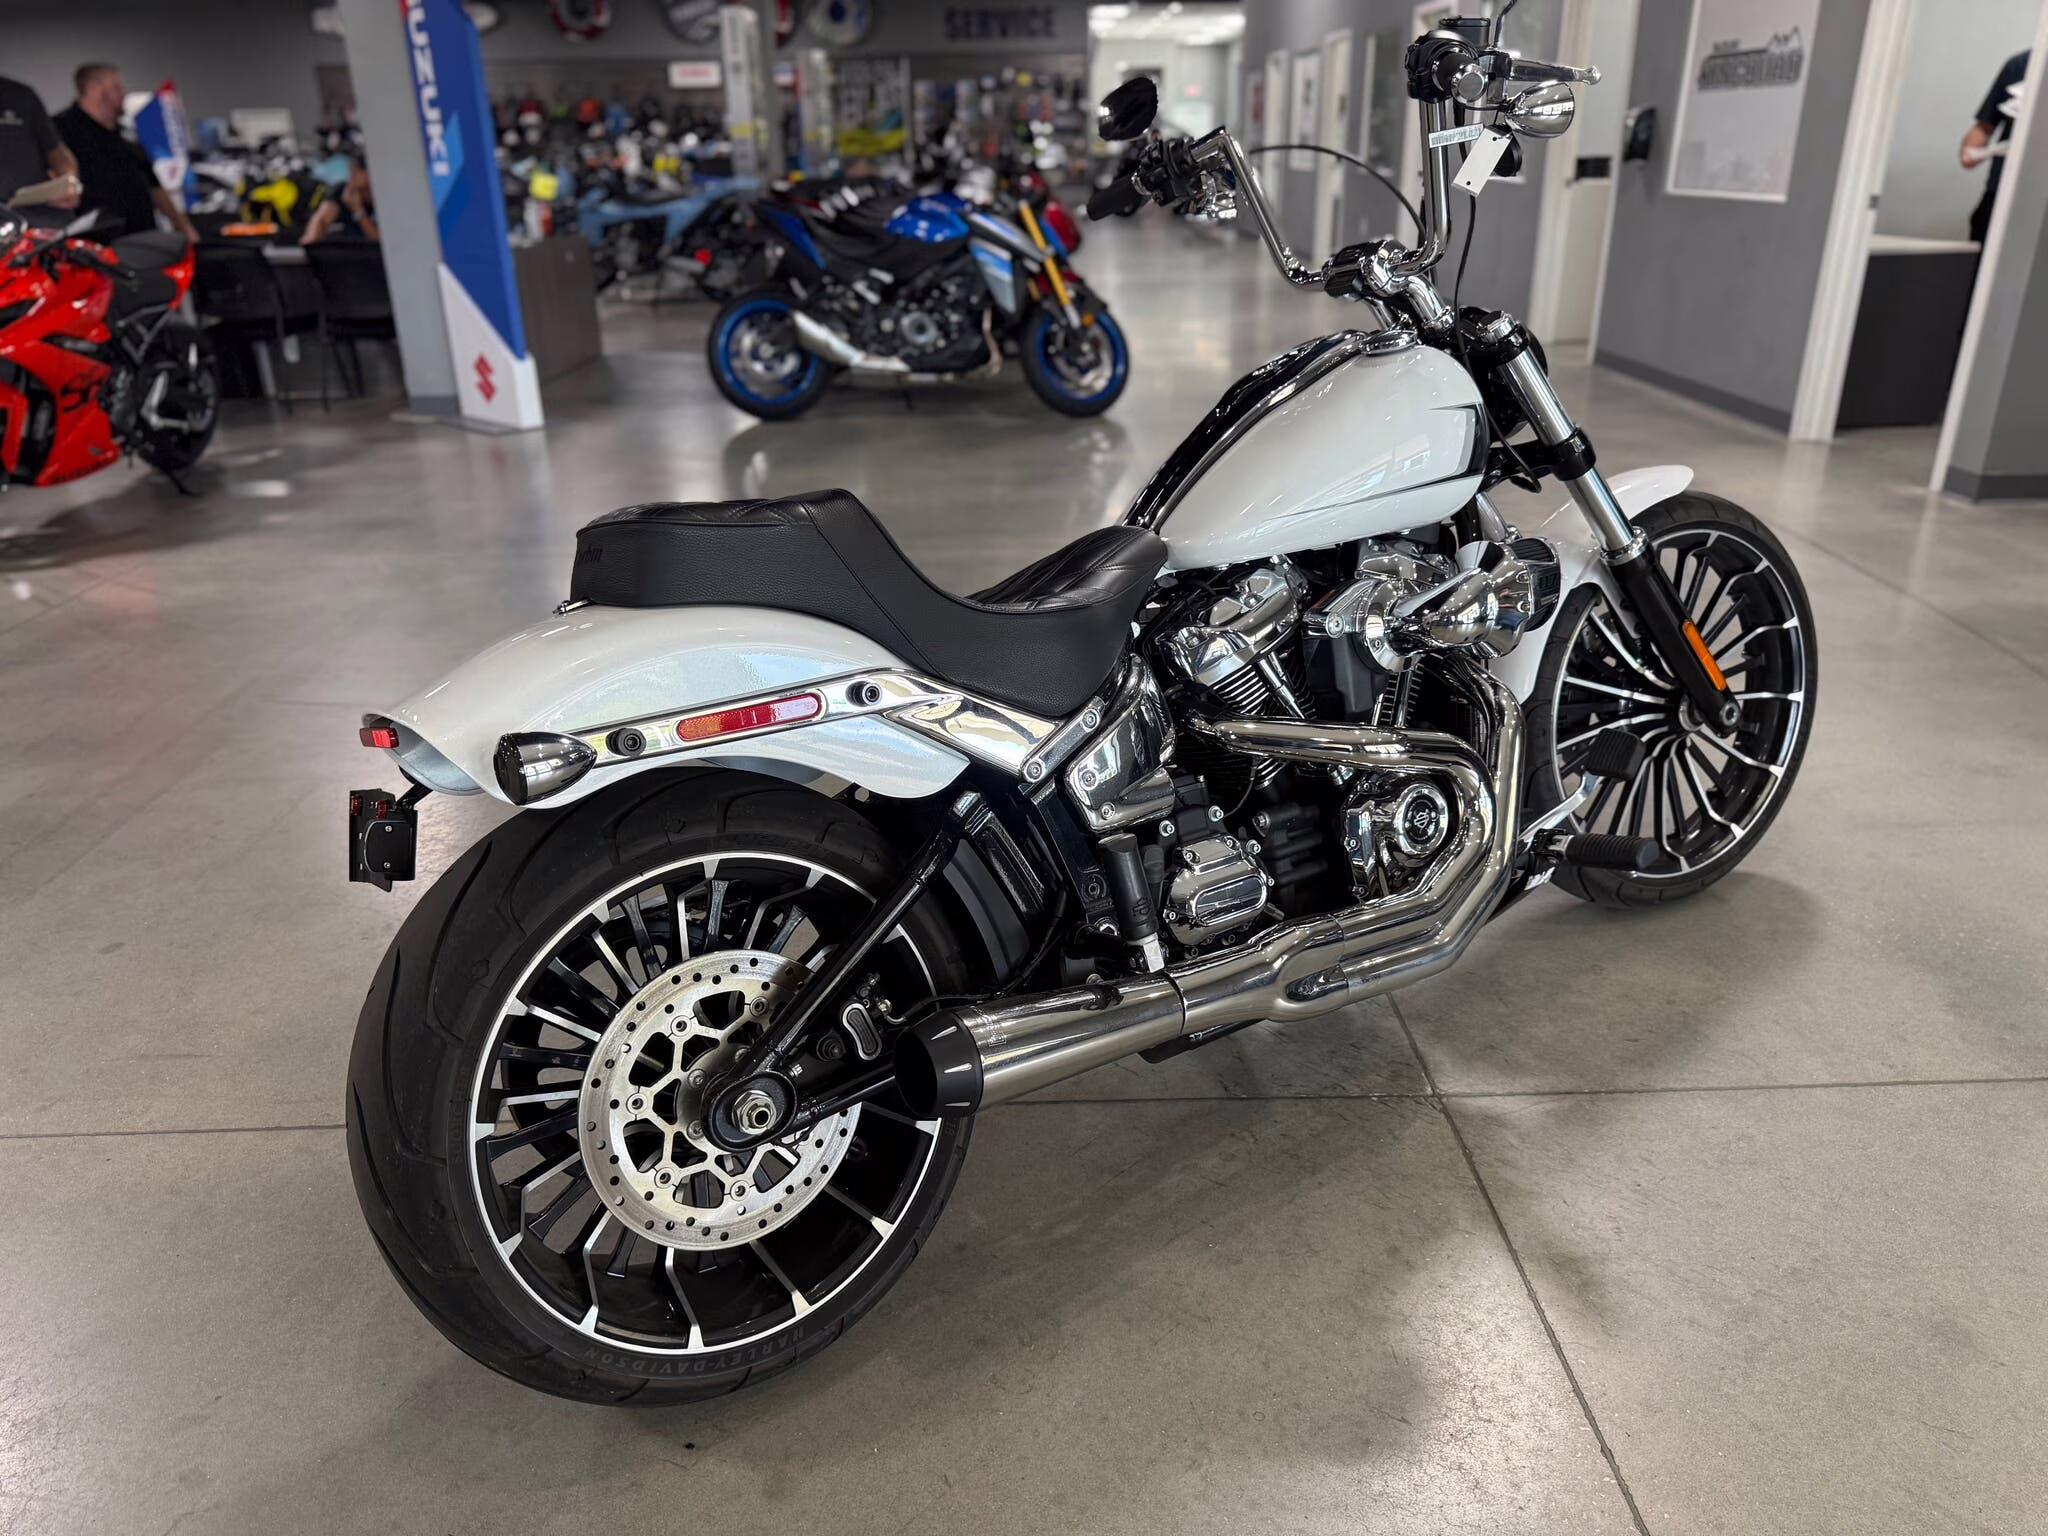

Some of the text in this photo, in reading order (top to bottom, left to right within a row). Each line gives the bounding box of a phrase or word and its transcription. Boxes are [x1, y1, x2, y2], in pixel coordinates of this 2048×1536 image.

[944, 8, 1056, 41] SERVICE
[407, 0, 450, 176] UZUKI
[583, 1326, 807, 1375] HARLEY-DAVIDSON
